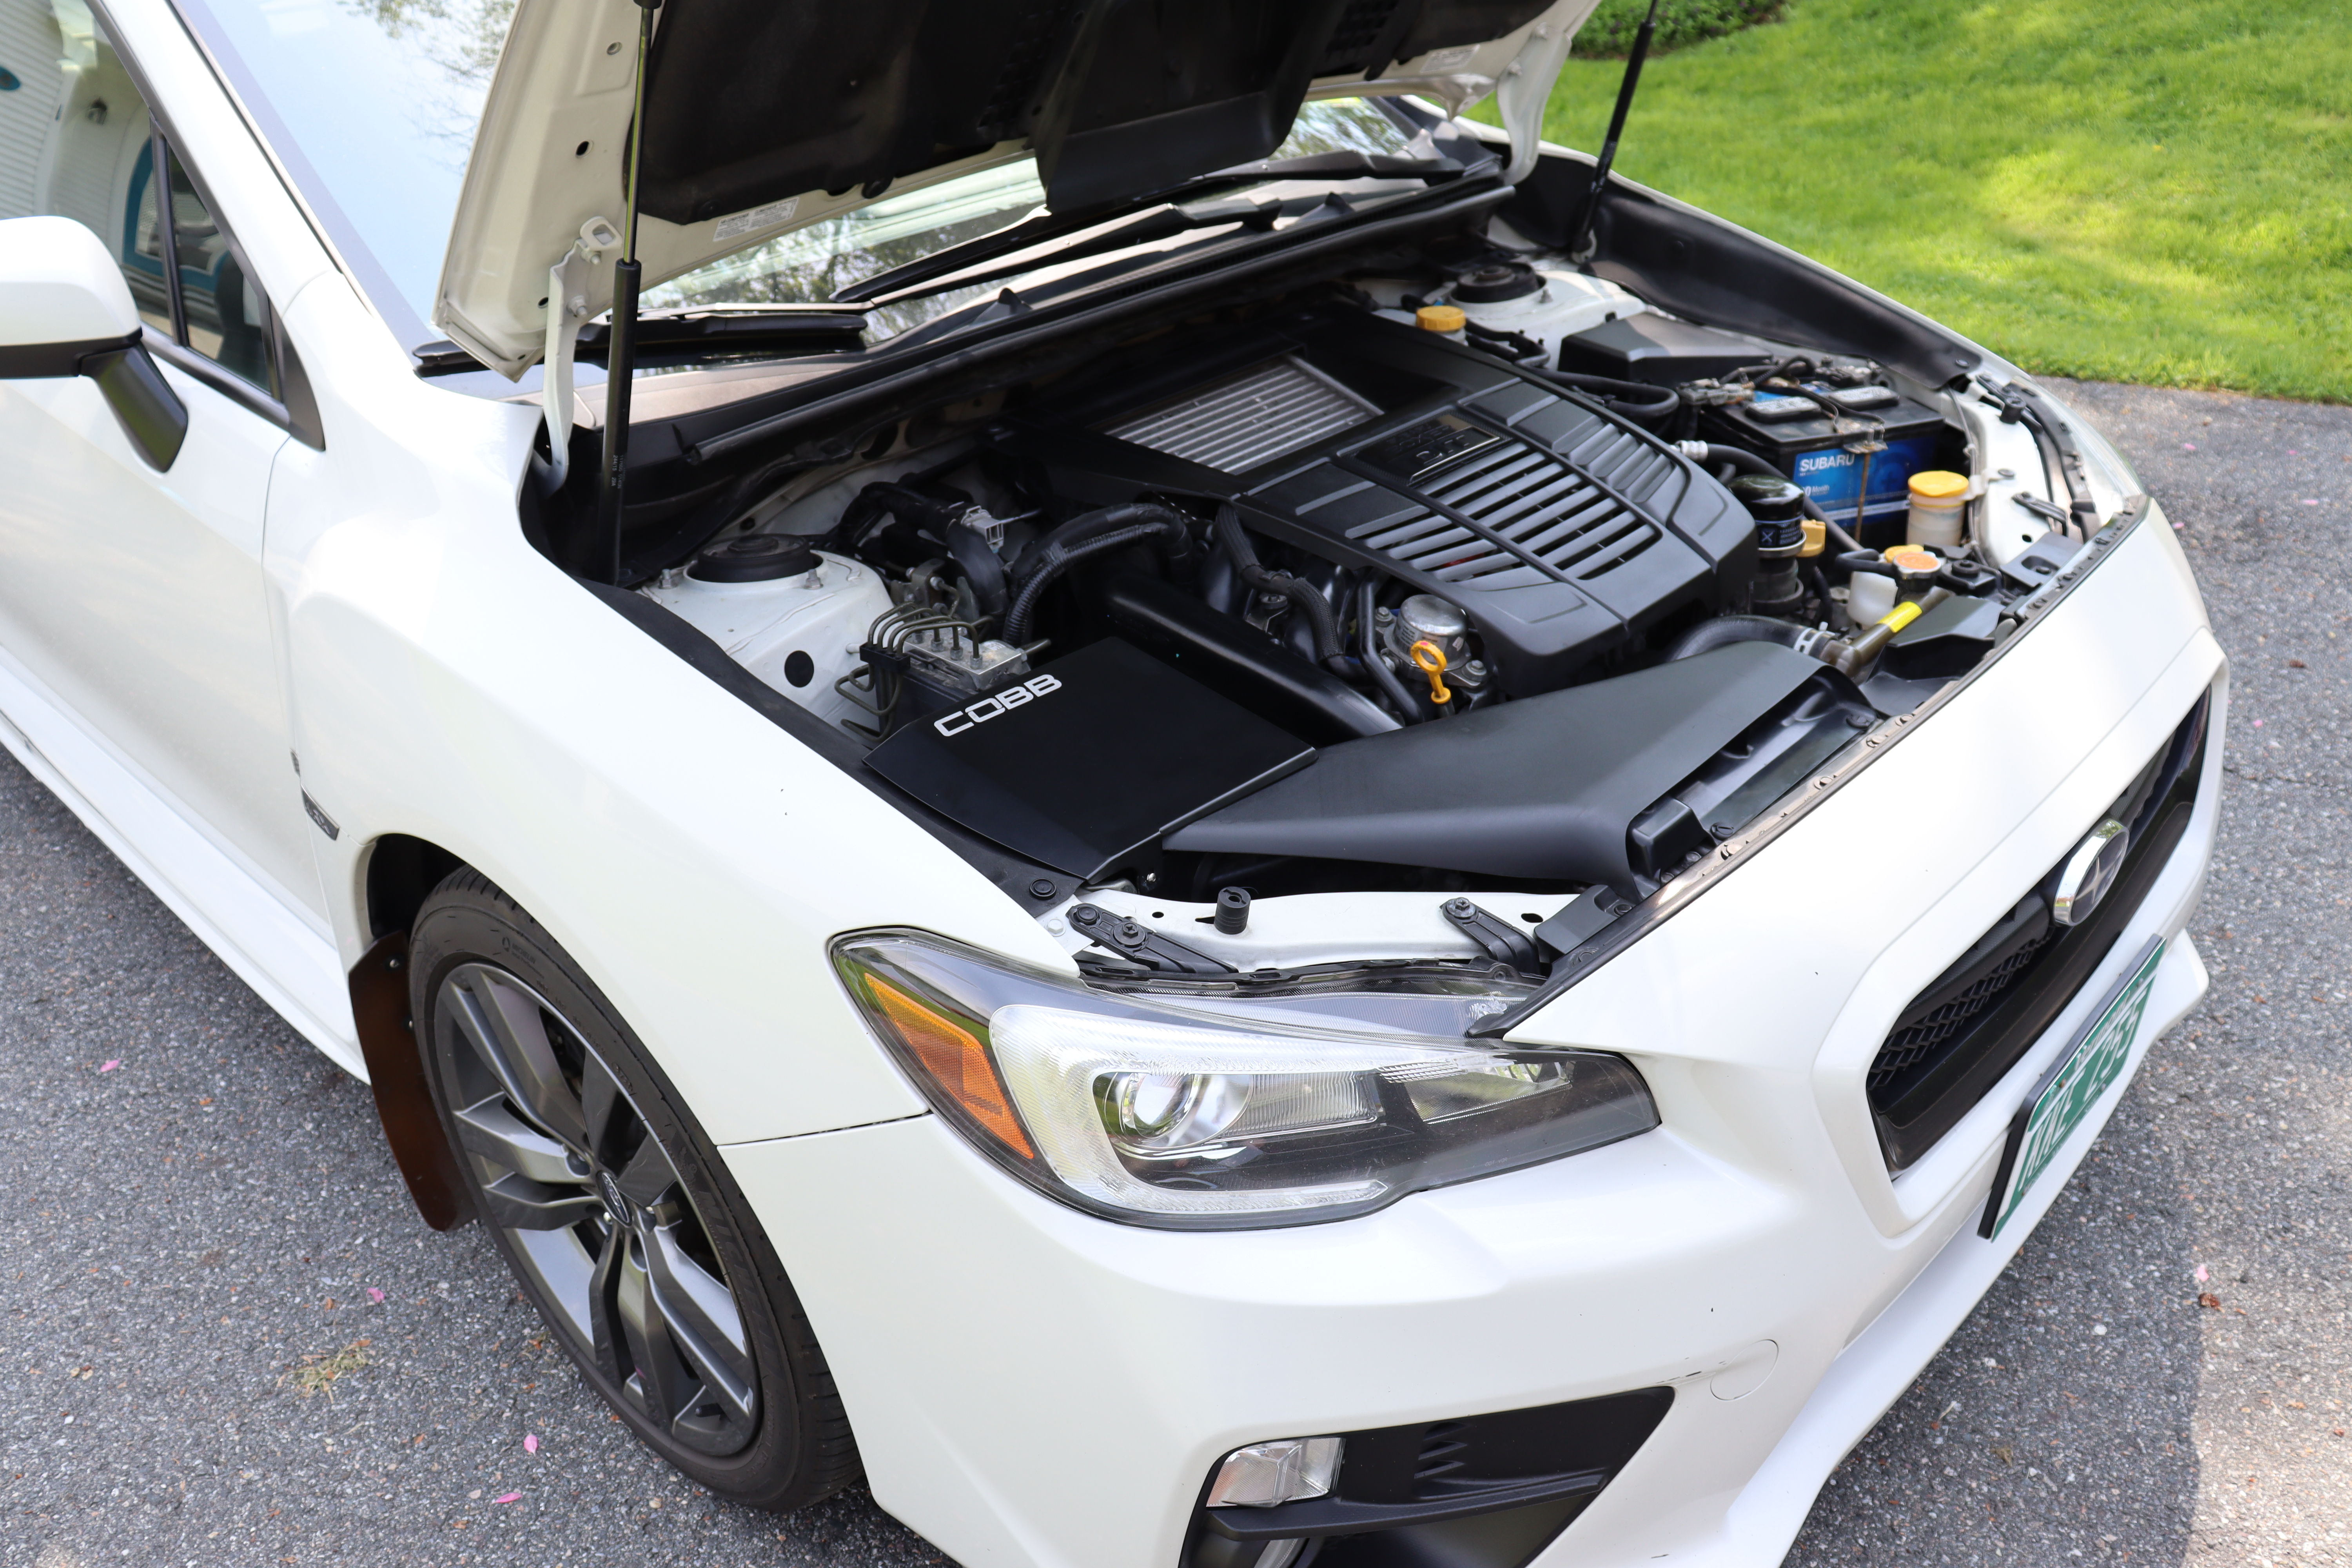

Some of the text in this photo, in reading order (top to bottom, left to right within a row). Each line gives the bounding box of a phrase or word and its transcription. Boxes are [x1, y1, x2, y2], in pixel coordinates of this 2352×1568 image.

[1799, 454, 1855, 472] SUBARU
[1812, 484, 1830, 493] Month
[933, 674, 1062, 737] COBB
[2074, 990, 2131, 1071] Vermont
[2018, 1067, 2086, 1191] KKE
[2083, 988, 2148, 1102] 255
[699, 1191, 782, 1372] MICHELIN
